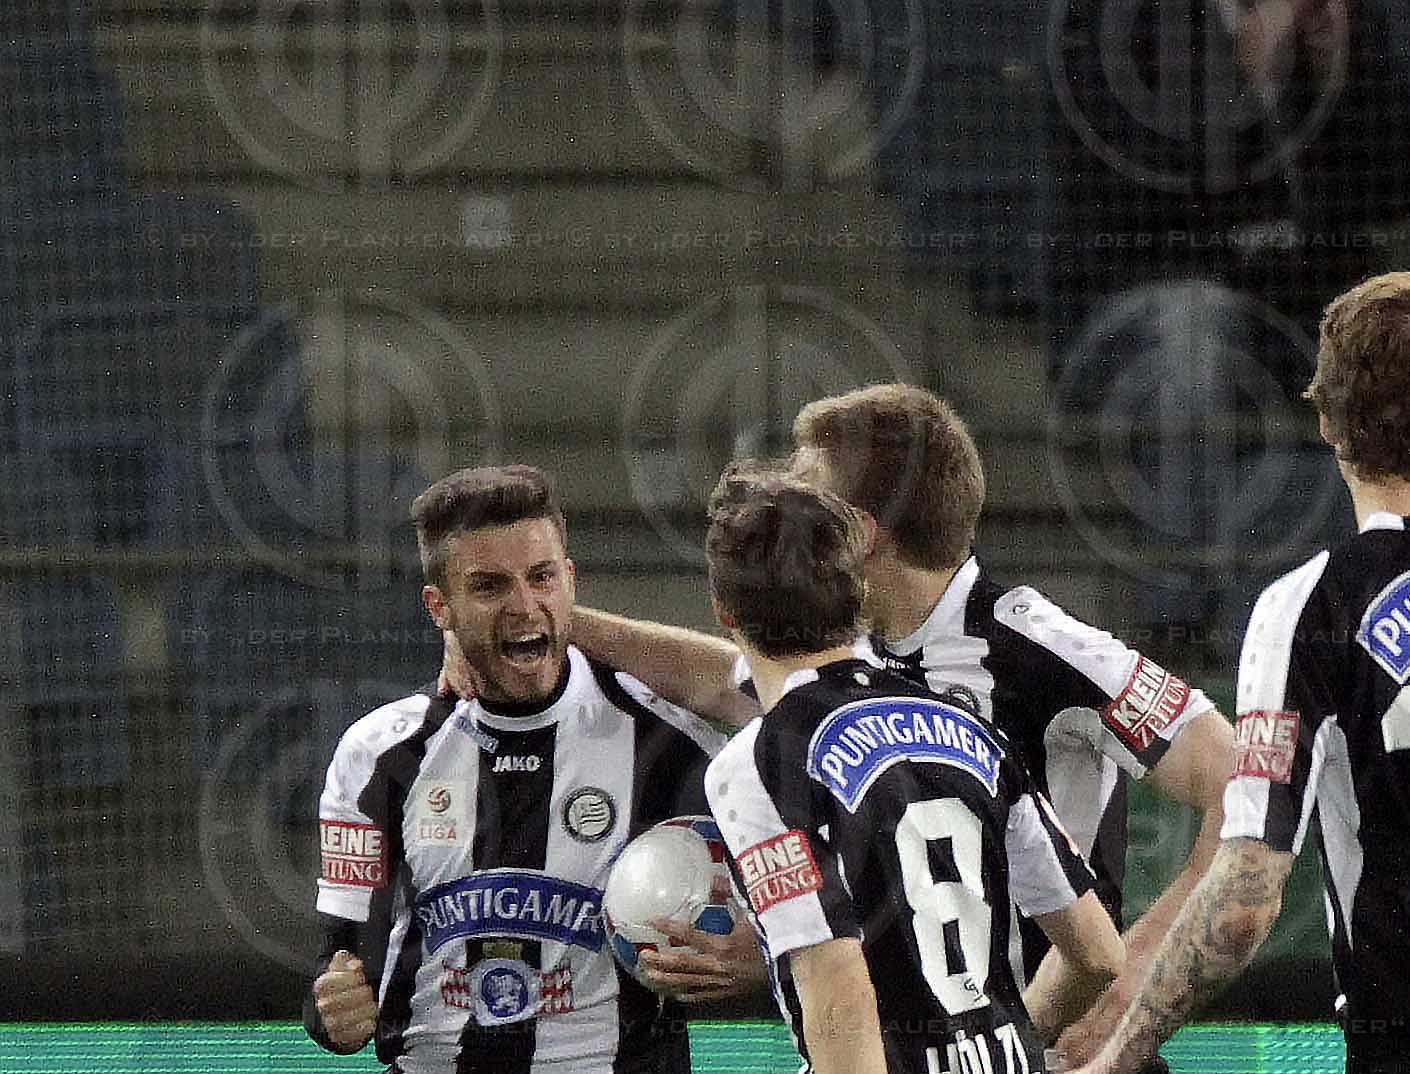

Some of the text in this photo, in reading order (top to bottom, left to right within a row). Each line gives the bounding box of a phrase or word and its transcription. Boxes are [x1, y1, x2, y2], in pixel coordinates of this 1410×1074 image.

[492, 755, 543, 773] JAKO
[821, 711, 993, 788] PUNTIGAMER
[895, 797, 992, 1016] 8
